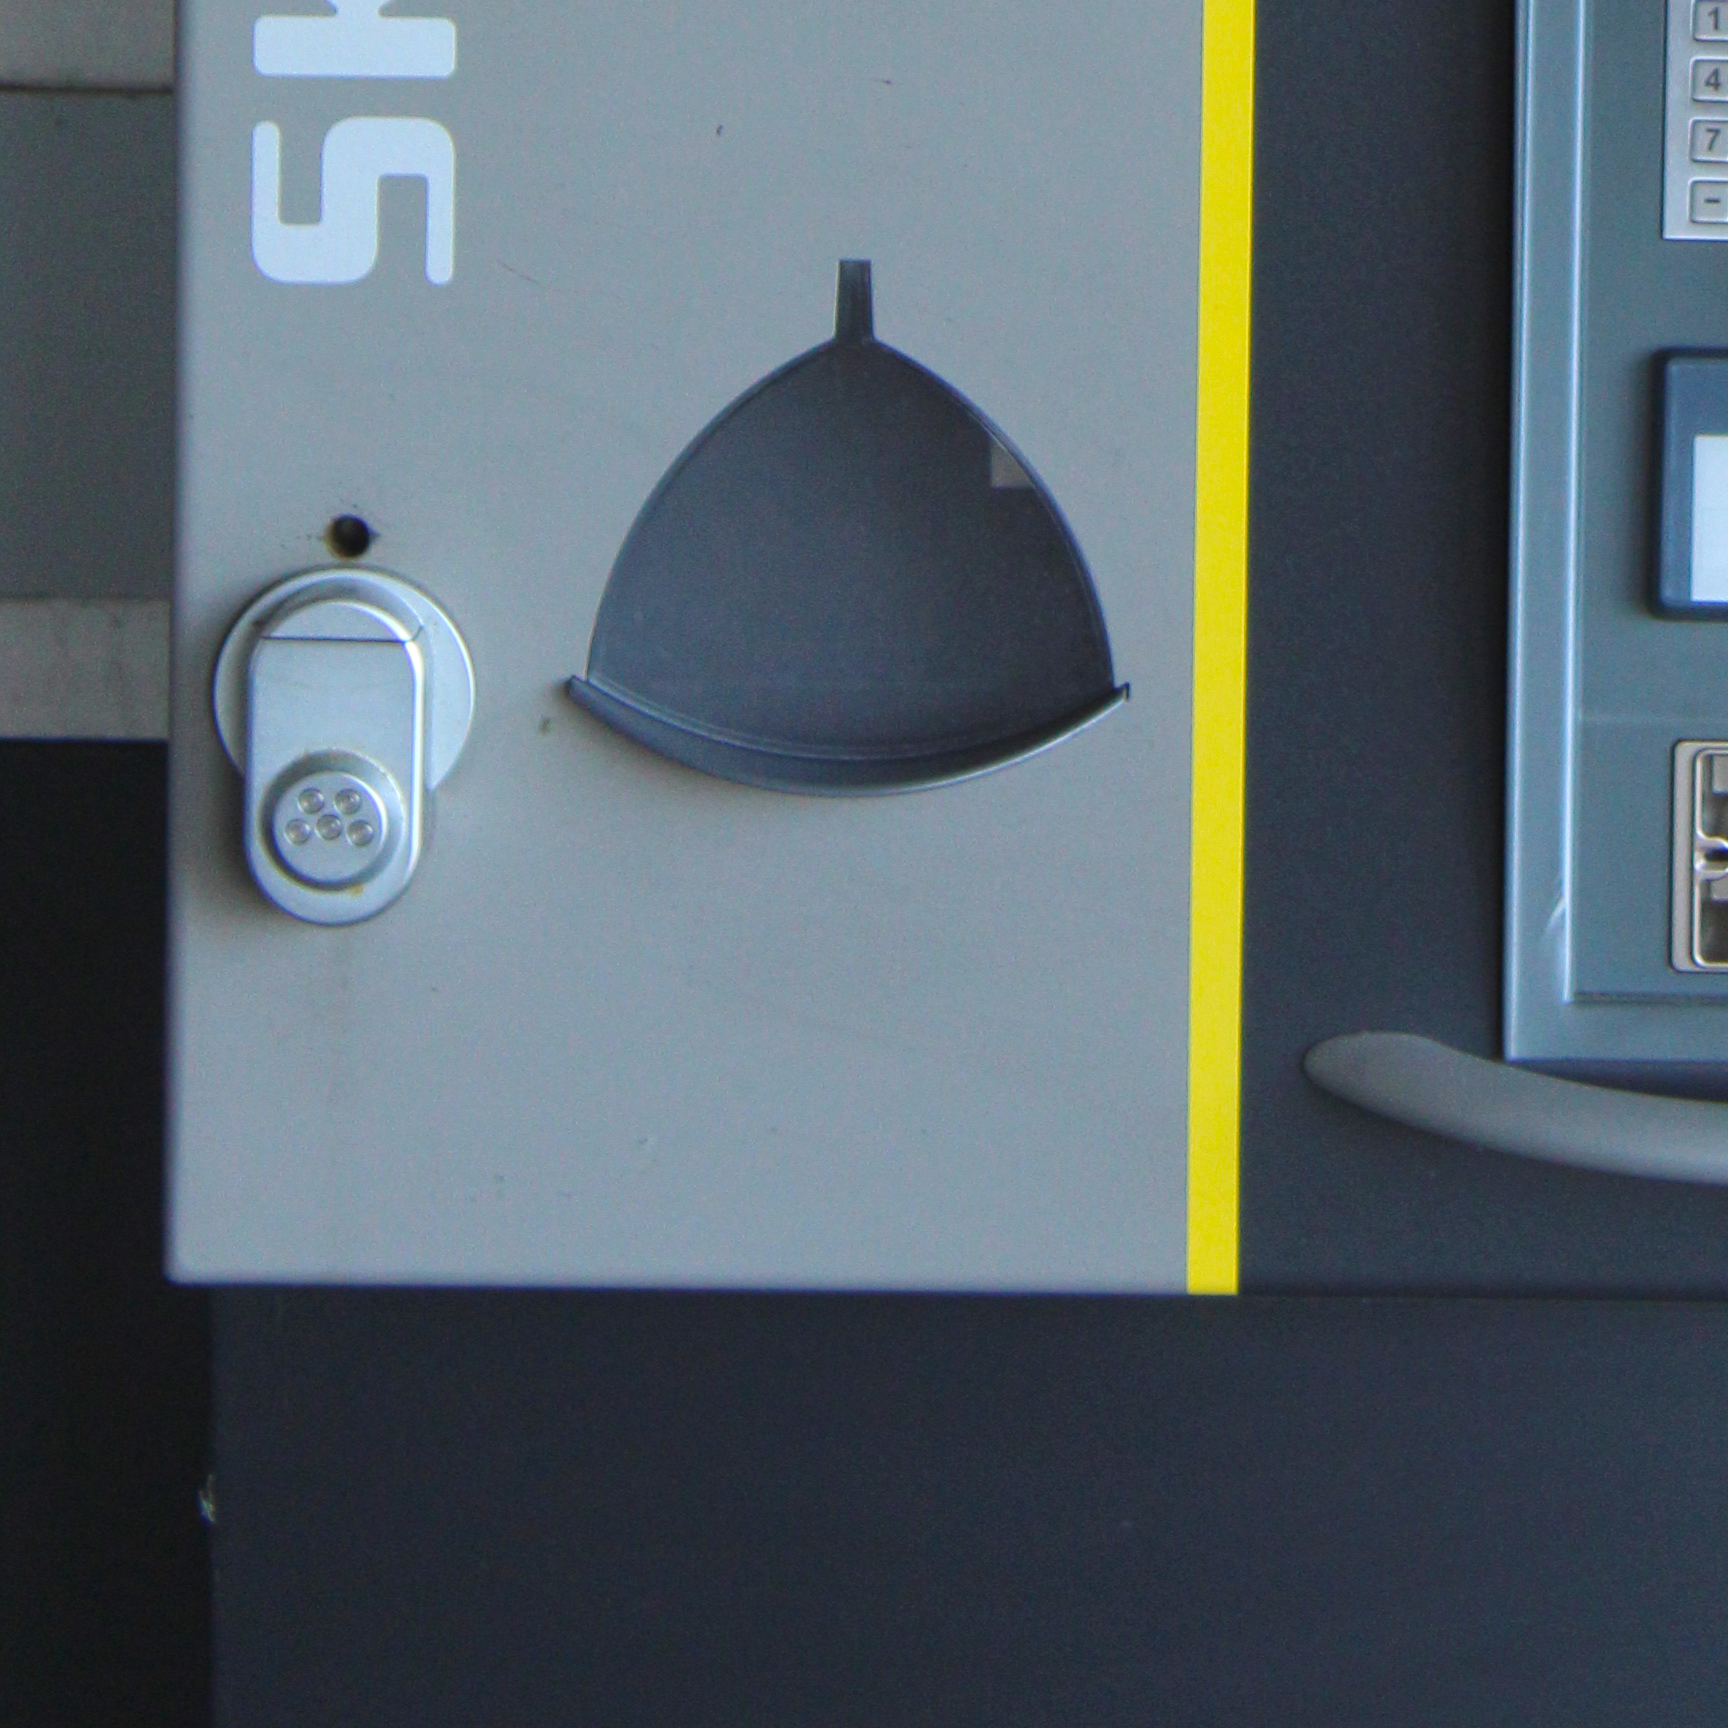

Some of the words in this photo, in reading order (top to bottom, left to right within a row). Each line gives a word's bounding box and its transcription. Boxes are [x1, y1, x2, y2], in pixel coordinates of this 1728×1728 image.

[1708, 7, 1720, 30] 1
[1705, 68, 1721, 91] 4
[1706, 128, 1721, 151] 7
